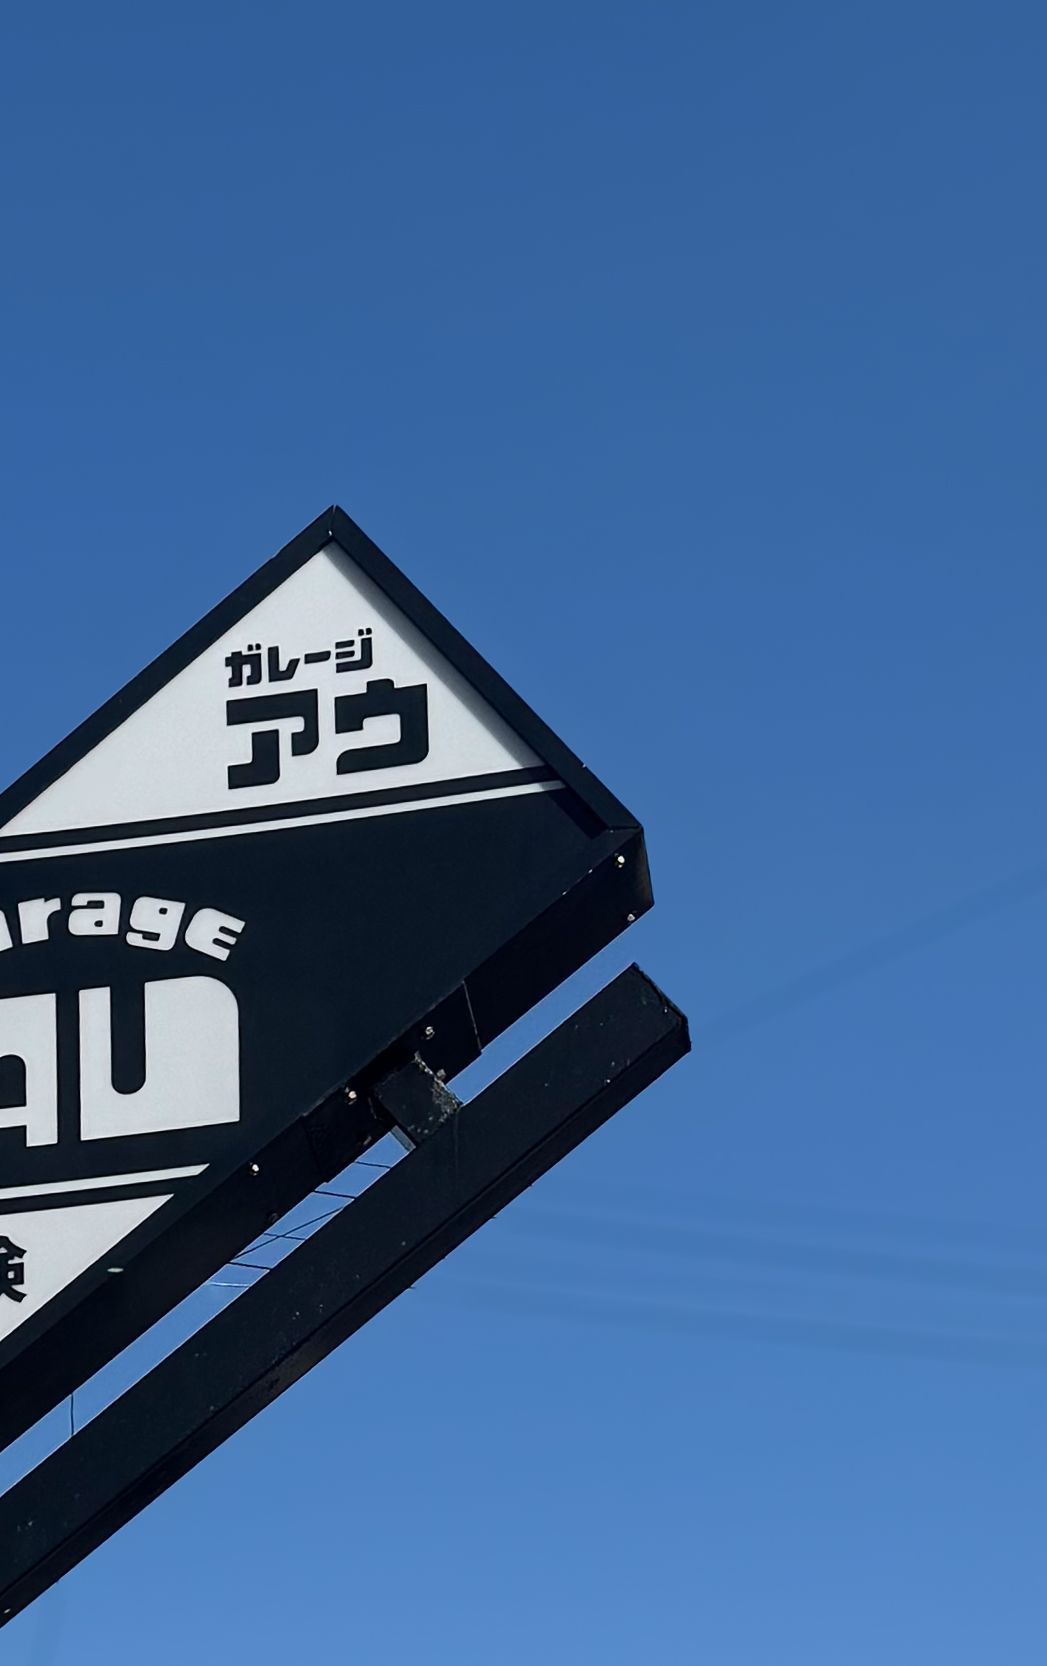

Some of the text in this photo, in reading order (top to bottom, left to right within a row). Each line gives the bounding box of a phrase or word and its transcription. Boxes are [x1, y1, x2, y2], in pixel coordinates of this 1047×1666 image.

[225, 628, 373, 688] ガレージ
[225, 677, 430, 790] アウ
